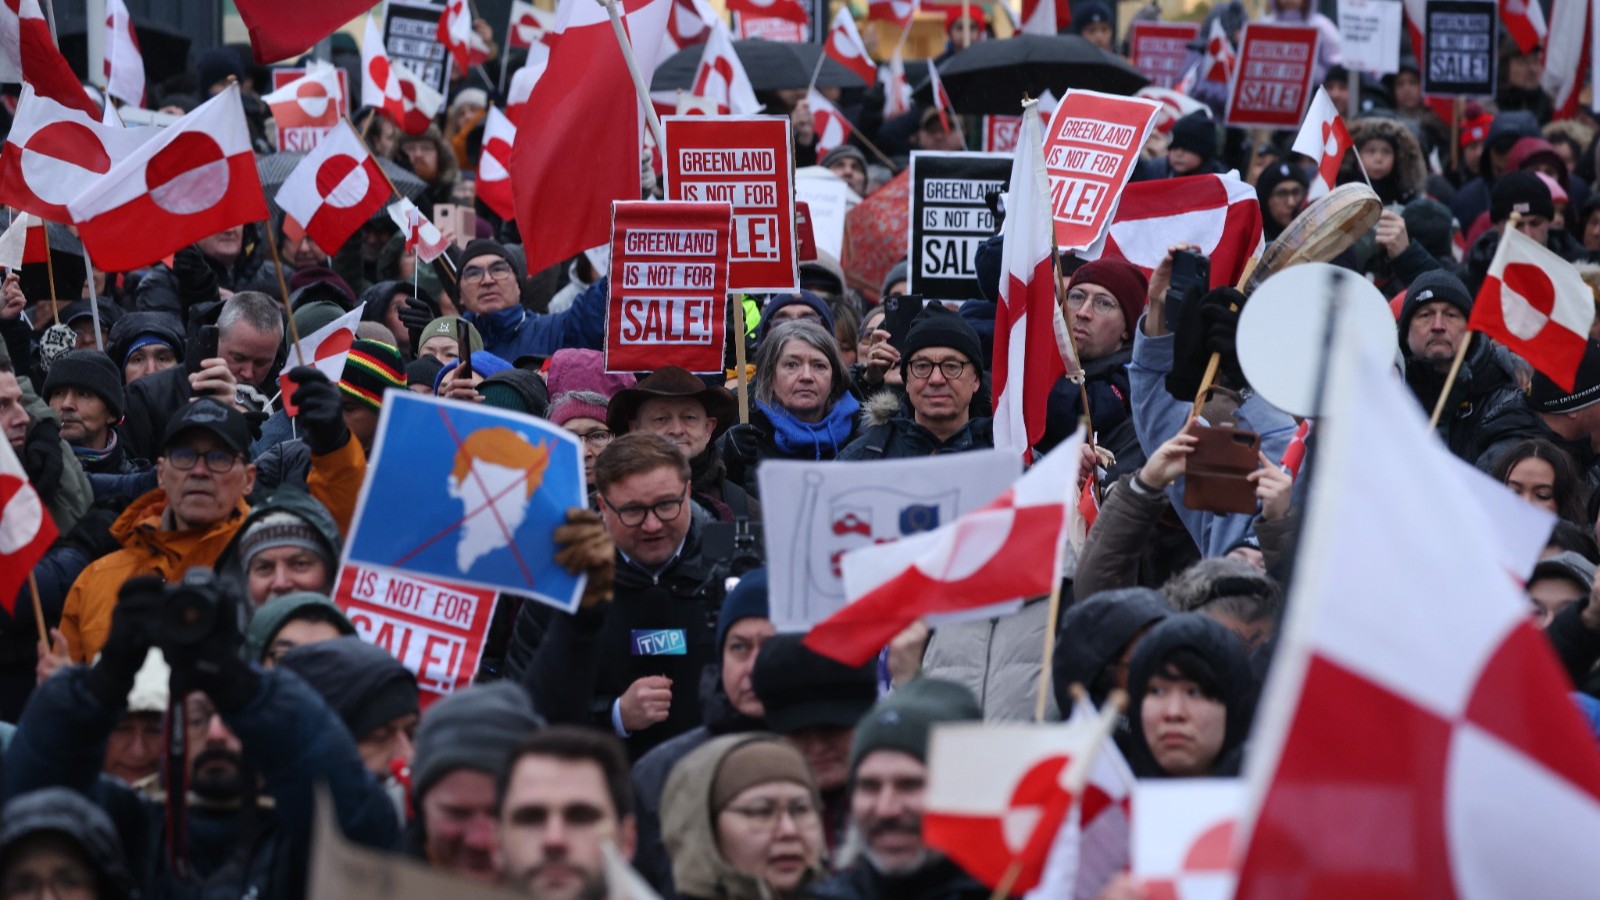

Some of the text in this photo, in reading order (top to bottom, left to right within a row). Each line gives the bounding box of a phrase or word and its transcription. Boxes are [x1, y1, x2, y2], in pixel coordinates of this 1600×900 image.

[1433, 55, 1487, 78] SALE!
[1239, 82, 1301, 111] SALE!
[1062, 120, 1133, 146] GREENLAND
[682, 151, 773, 172] GREENLAND
[1047, 148, 1119, 174] IS NOT FOR
[683, 184, 774, 206] IS NOT FOR
[926, 210, 995, 230] IS NOT FO
[627, 232, 714, 253] GREENLAND
[731, 217, 778, 258] LE!
[925, 239, 979, 275] SAL
[625, 265, 712, 287] IS NOT FOR
[623, 299, 712, 342] SALE!
[356, 569, 472, 624] IS NOT FOR
[640, 631, 680, 654] TVP
